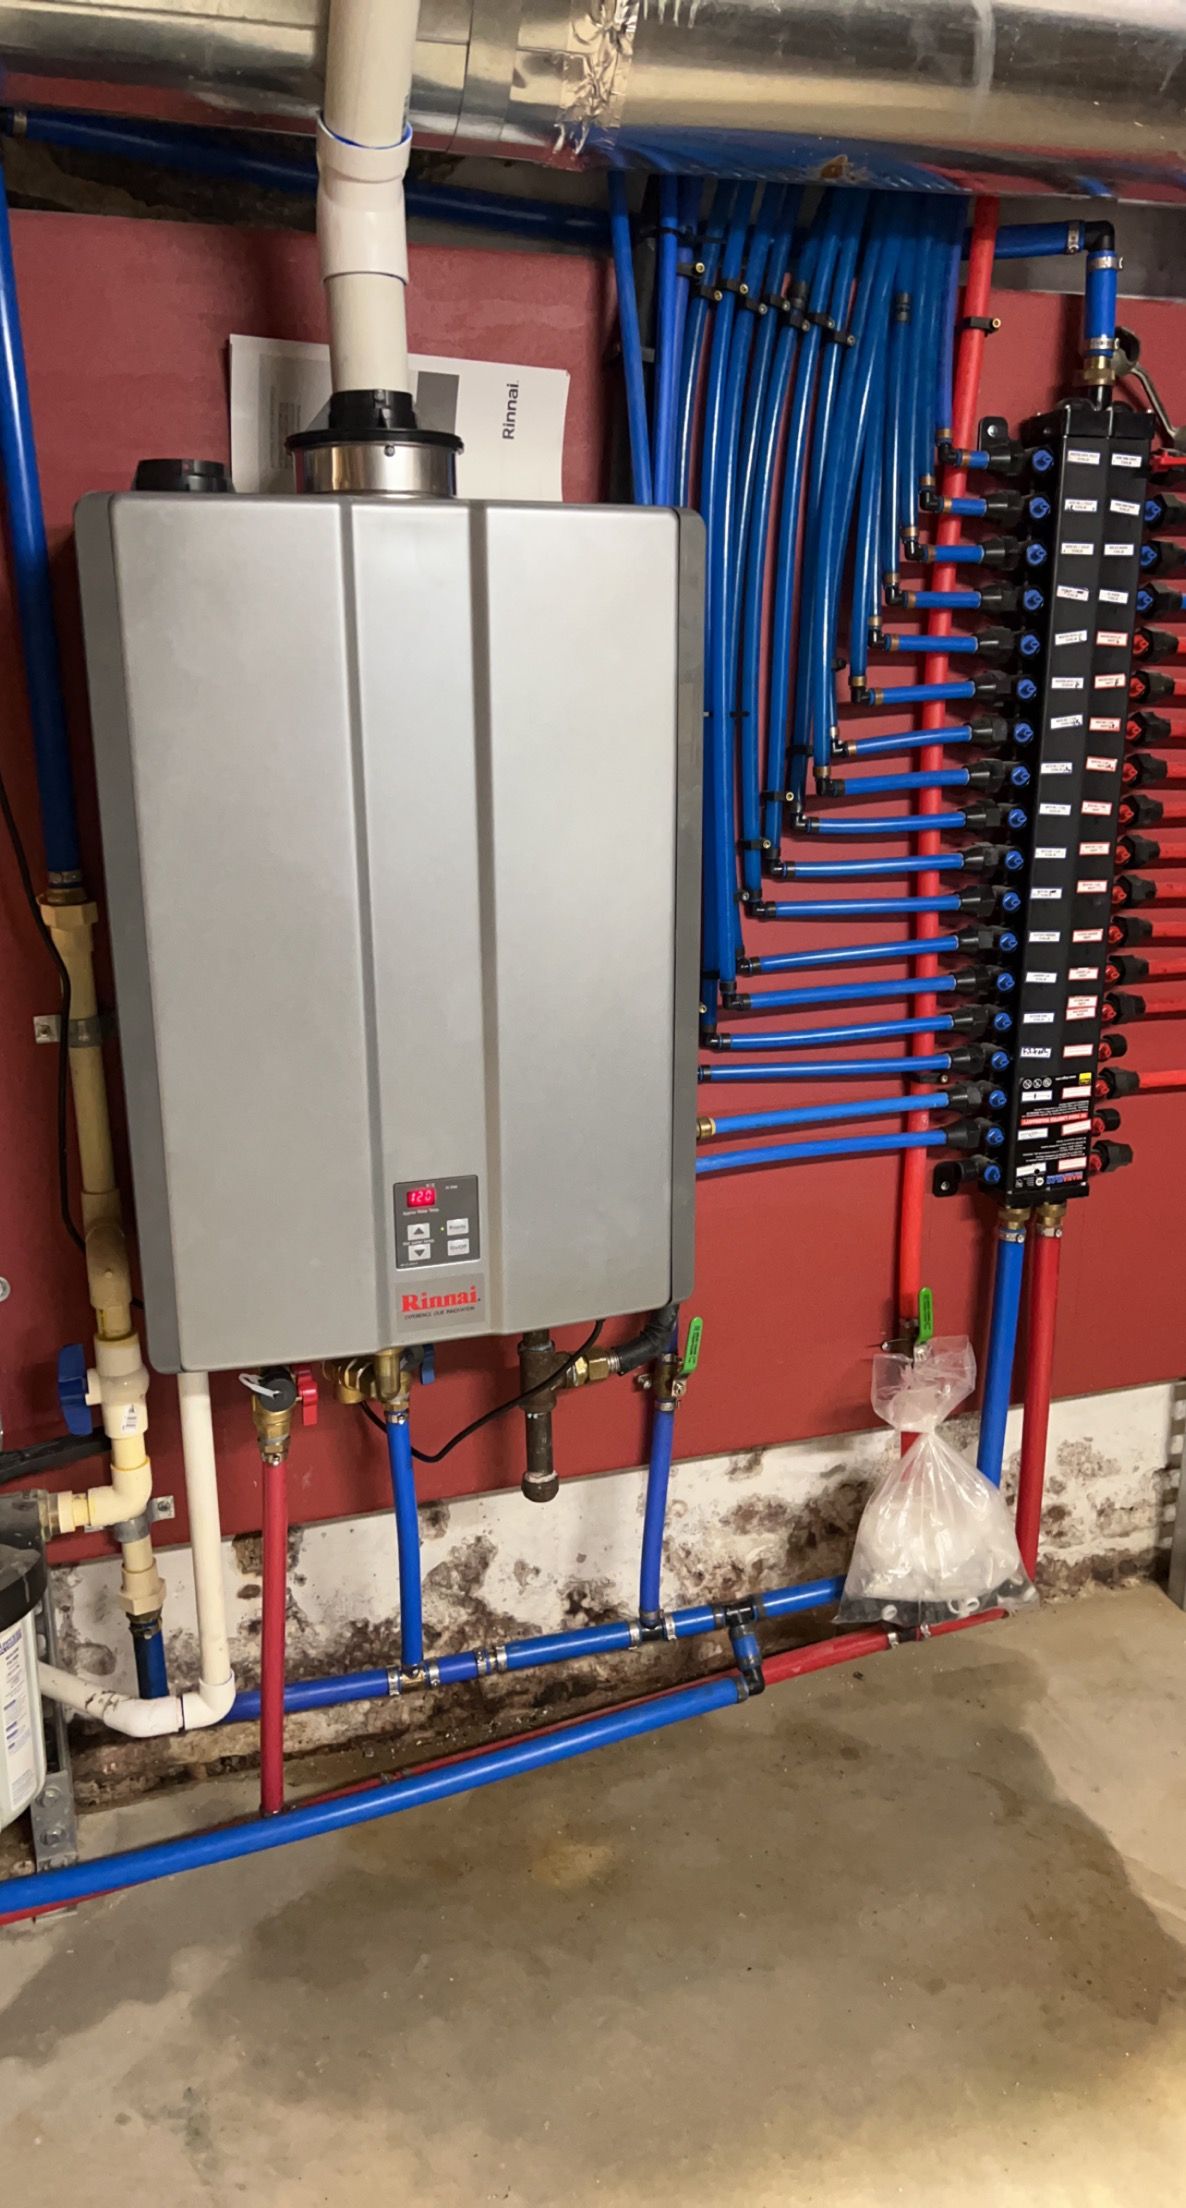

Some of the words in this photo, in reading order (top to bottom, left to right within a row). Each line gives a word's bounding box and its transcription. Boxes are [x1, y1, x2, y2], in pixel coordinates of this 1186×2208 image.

[502, 383, 519, 440] Rinnai
[411, 1190, 432, 1202] 120
[402, 1285, 477, 1312] Rinnai
